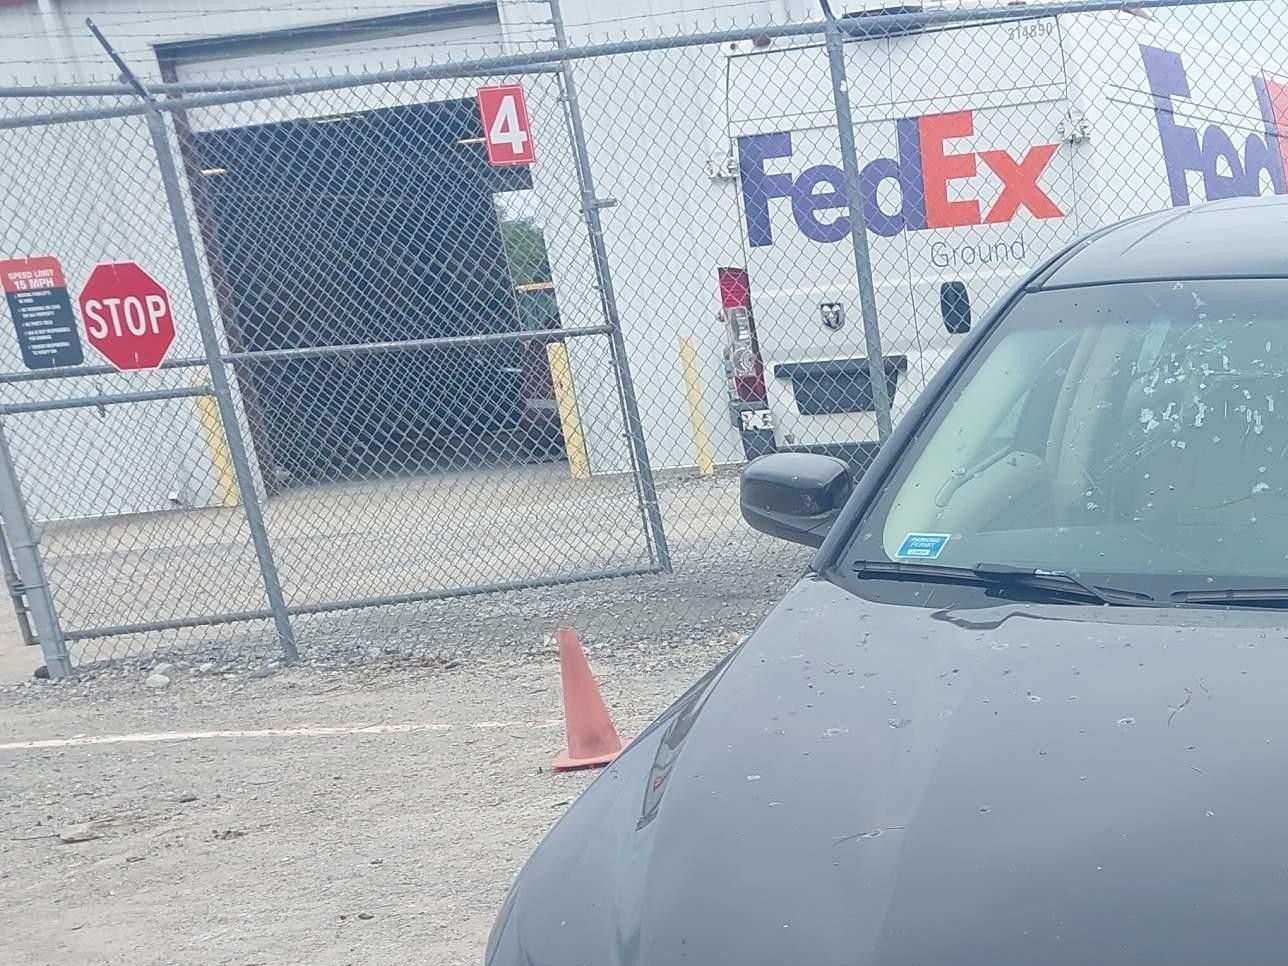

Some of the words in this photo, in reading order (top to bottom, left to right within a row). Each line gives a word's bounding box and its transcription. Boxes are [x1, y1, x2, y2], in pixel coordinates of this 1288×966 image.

[490, 95, 528, 154] 4
[738, 110, 1066, 248] FedEx
[930, 233, 1026, 268] Ground
[8, 271, 33, 280] SPEED
[34, 268, 54, 278] LIMIT
[14, 280, 27, 290] 15
[28, 278, 55, 289] MPH
[85, 295, 166, 339] STOP
